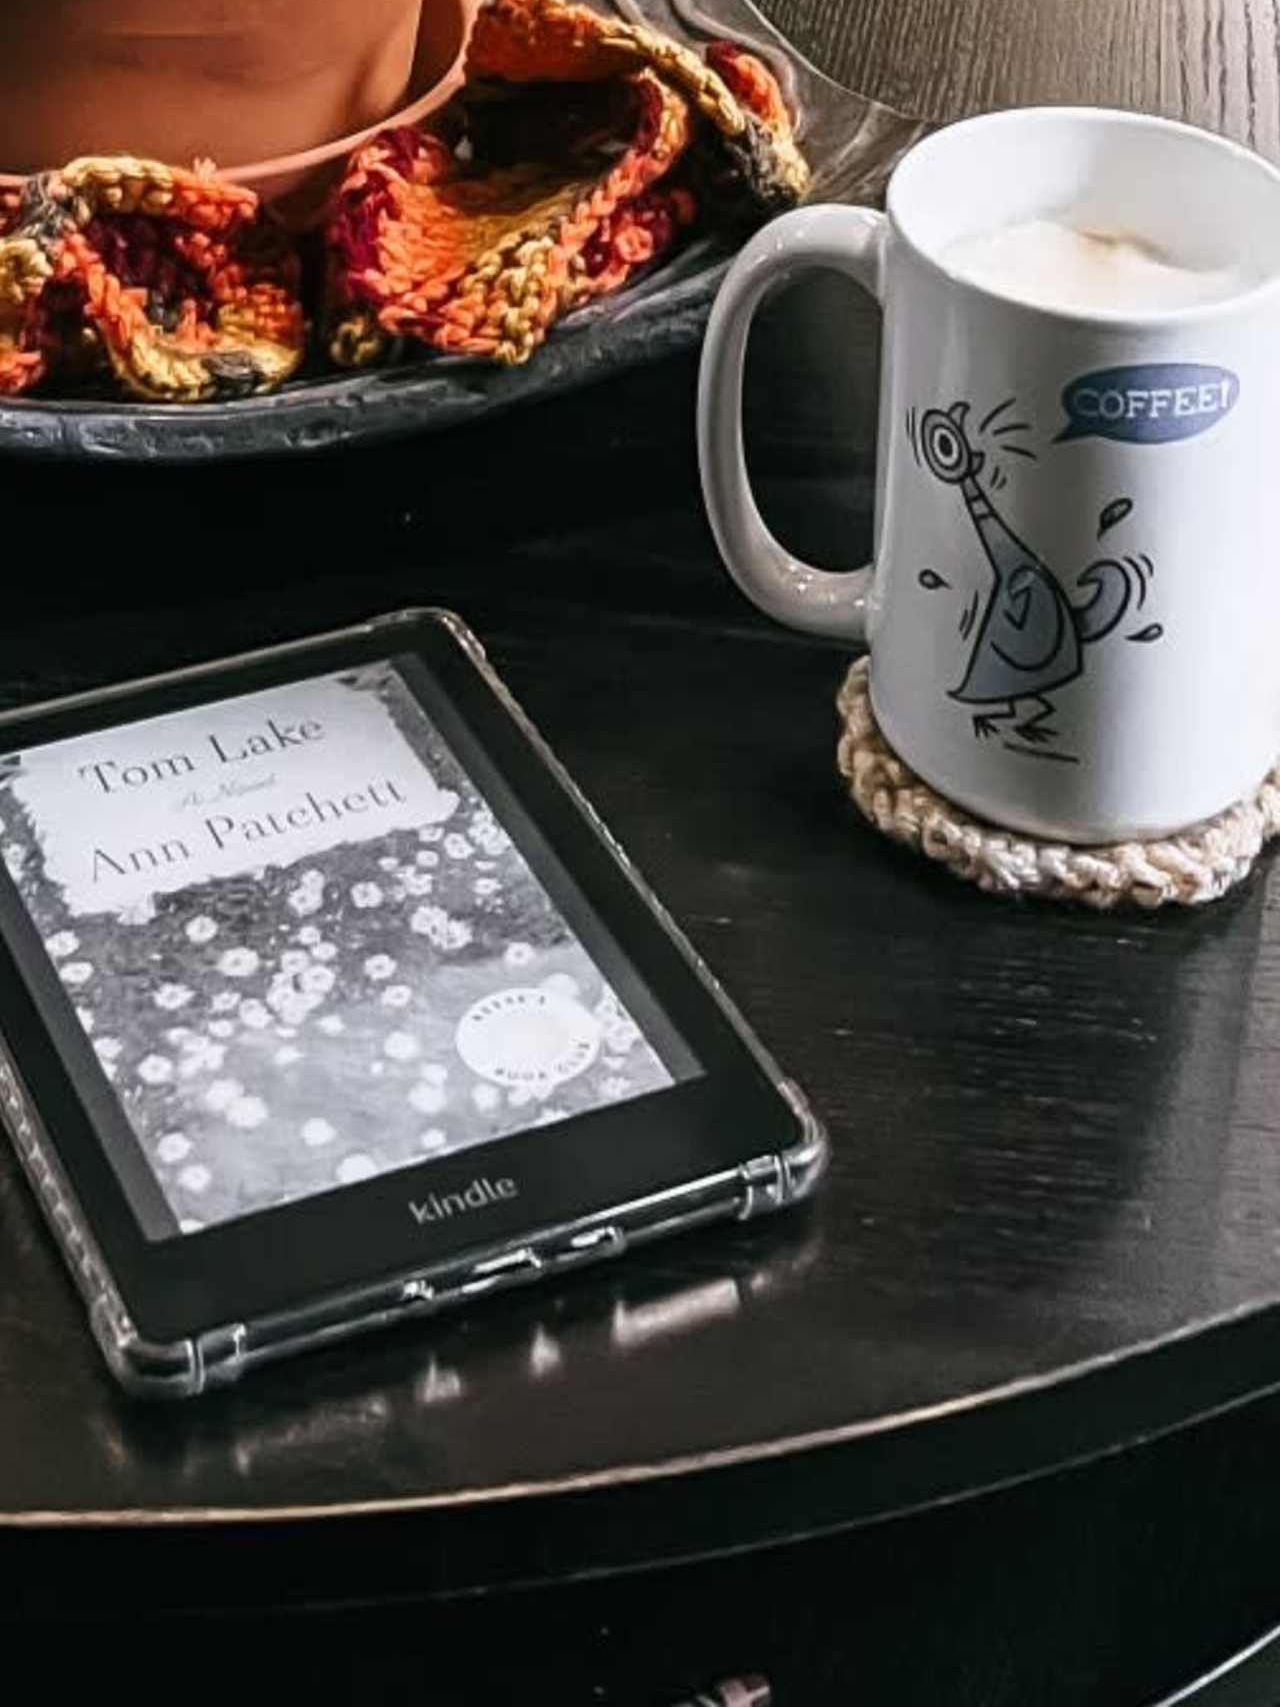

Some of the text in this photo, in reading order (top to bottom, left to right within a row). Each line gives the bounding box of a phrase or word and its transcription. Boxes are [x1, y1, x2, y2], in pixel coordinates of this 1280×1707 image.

[1072, 378, 1232, 420] COFFEE!
[76, 718, 324, 794] Tom Lake
[91, 778, 408, 884] Ann Patchett
[407, 1177, 519, 1225] kindle
